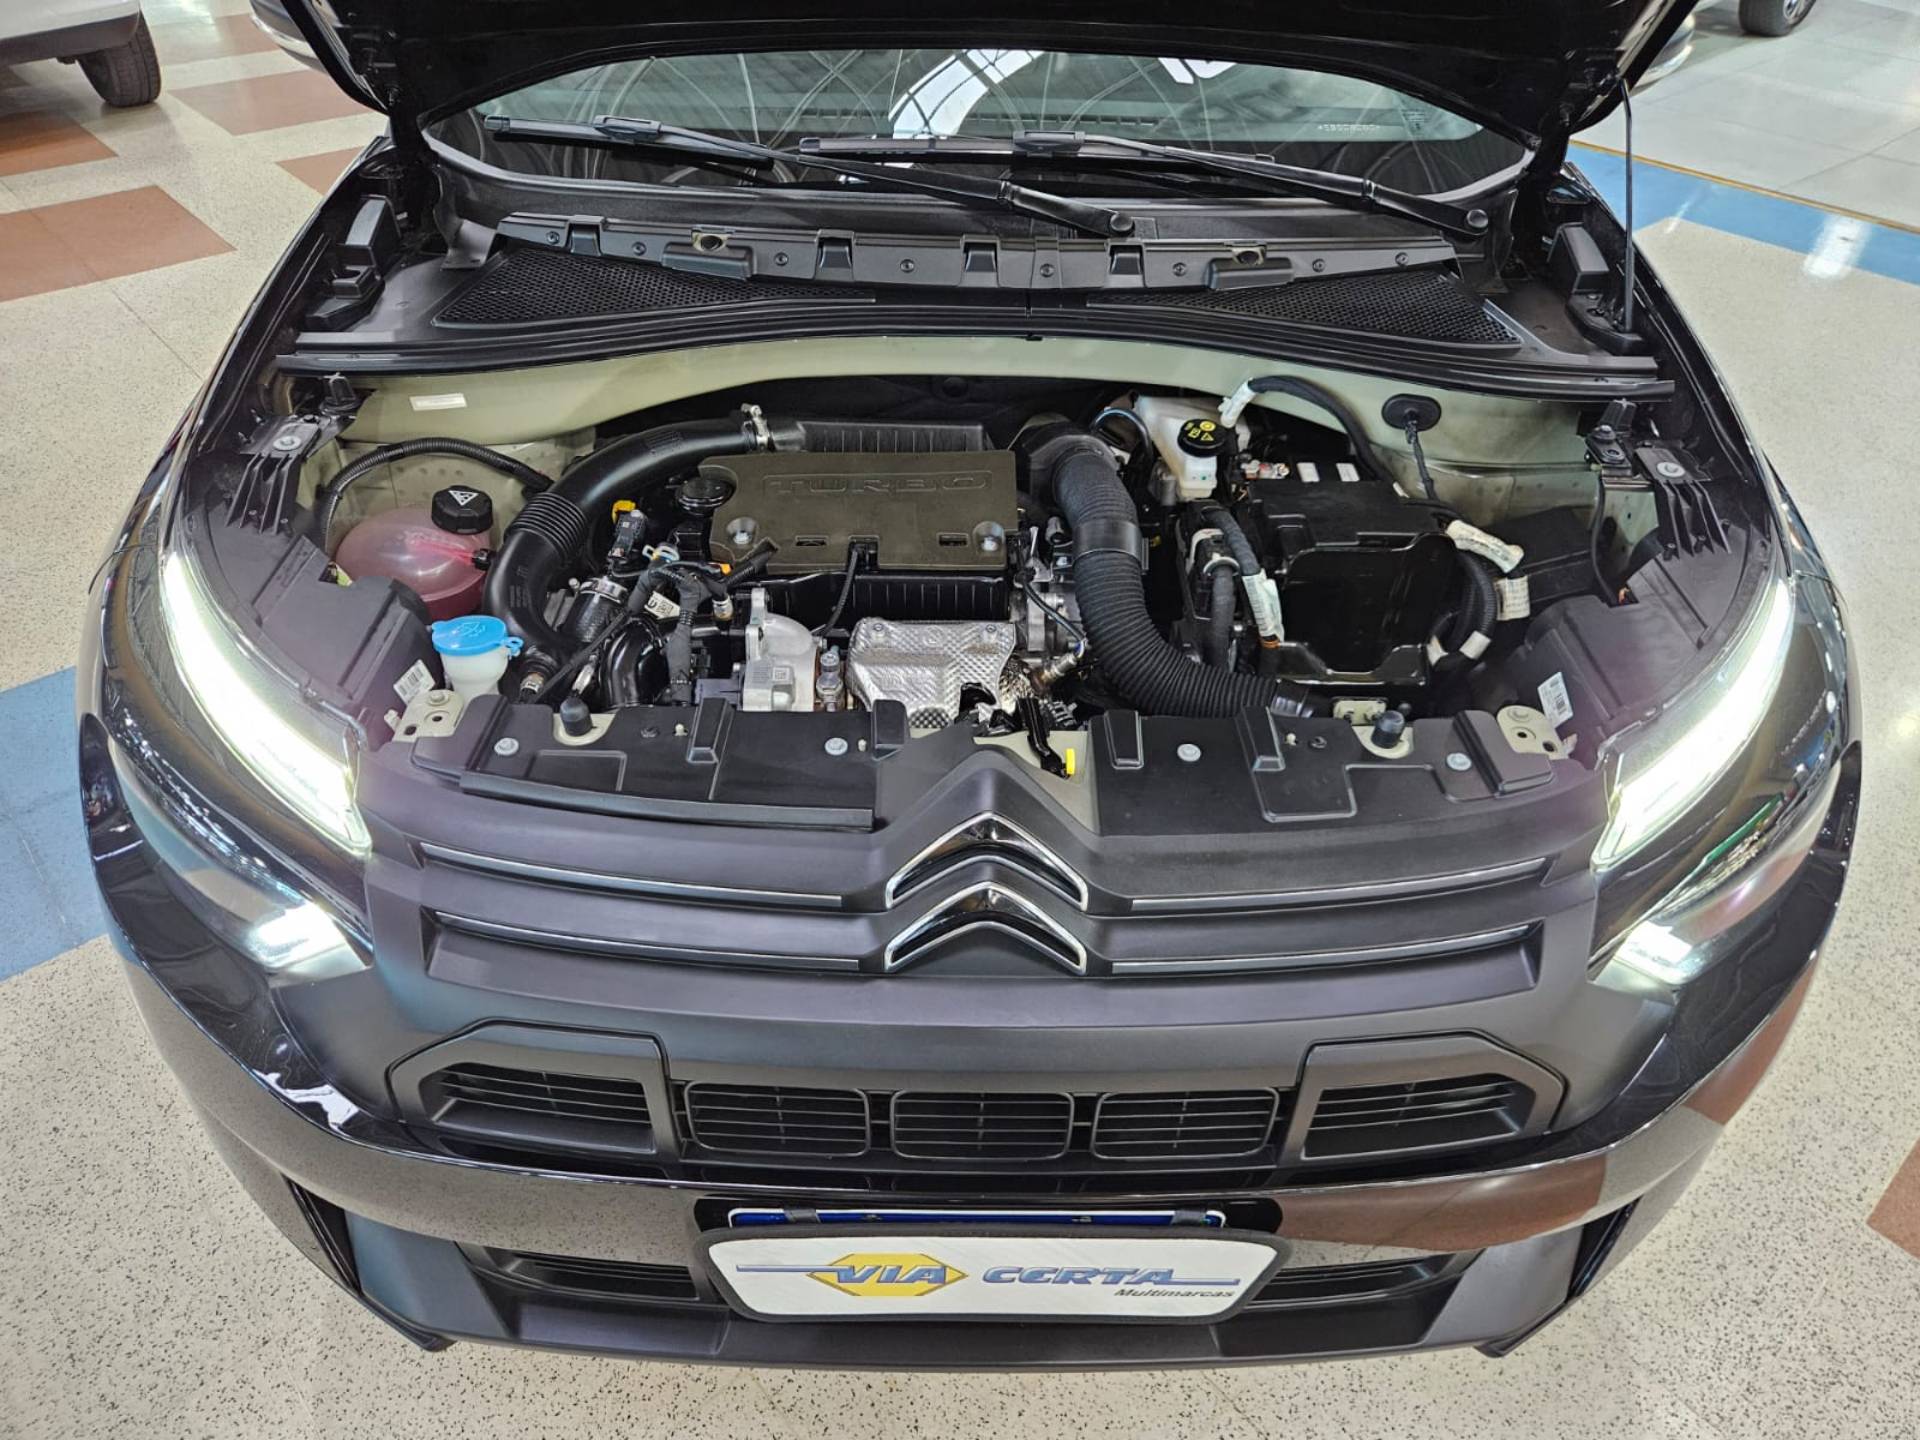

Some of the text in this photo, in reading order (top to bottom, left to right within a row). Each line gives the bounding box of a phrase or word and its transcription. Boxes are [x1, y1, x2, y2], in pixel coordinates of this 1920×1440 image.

[768, 476, 987, 494] TURBO
[836, 1264, 1175, 1285] VIA CERTA
[1113, 1287, 1235, 1298] Multimarcas
